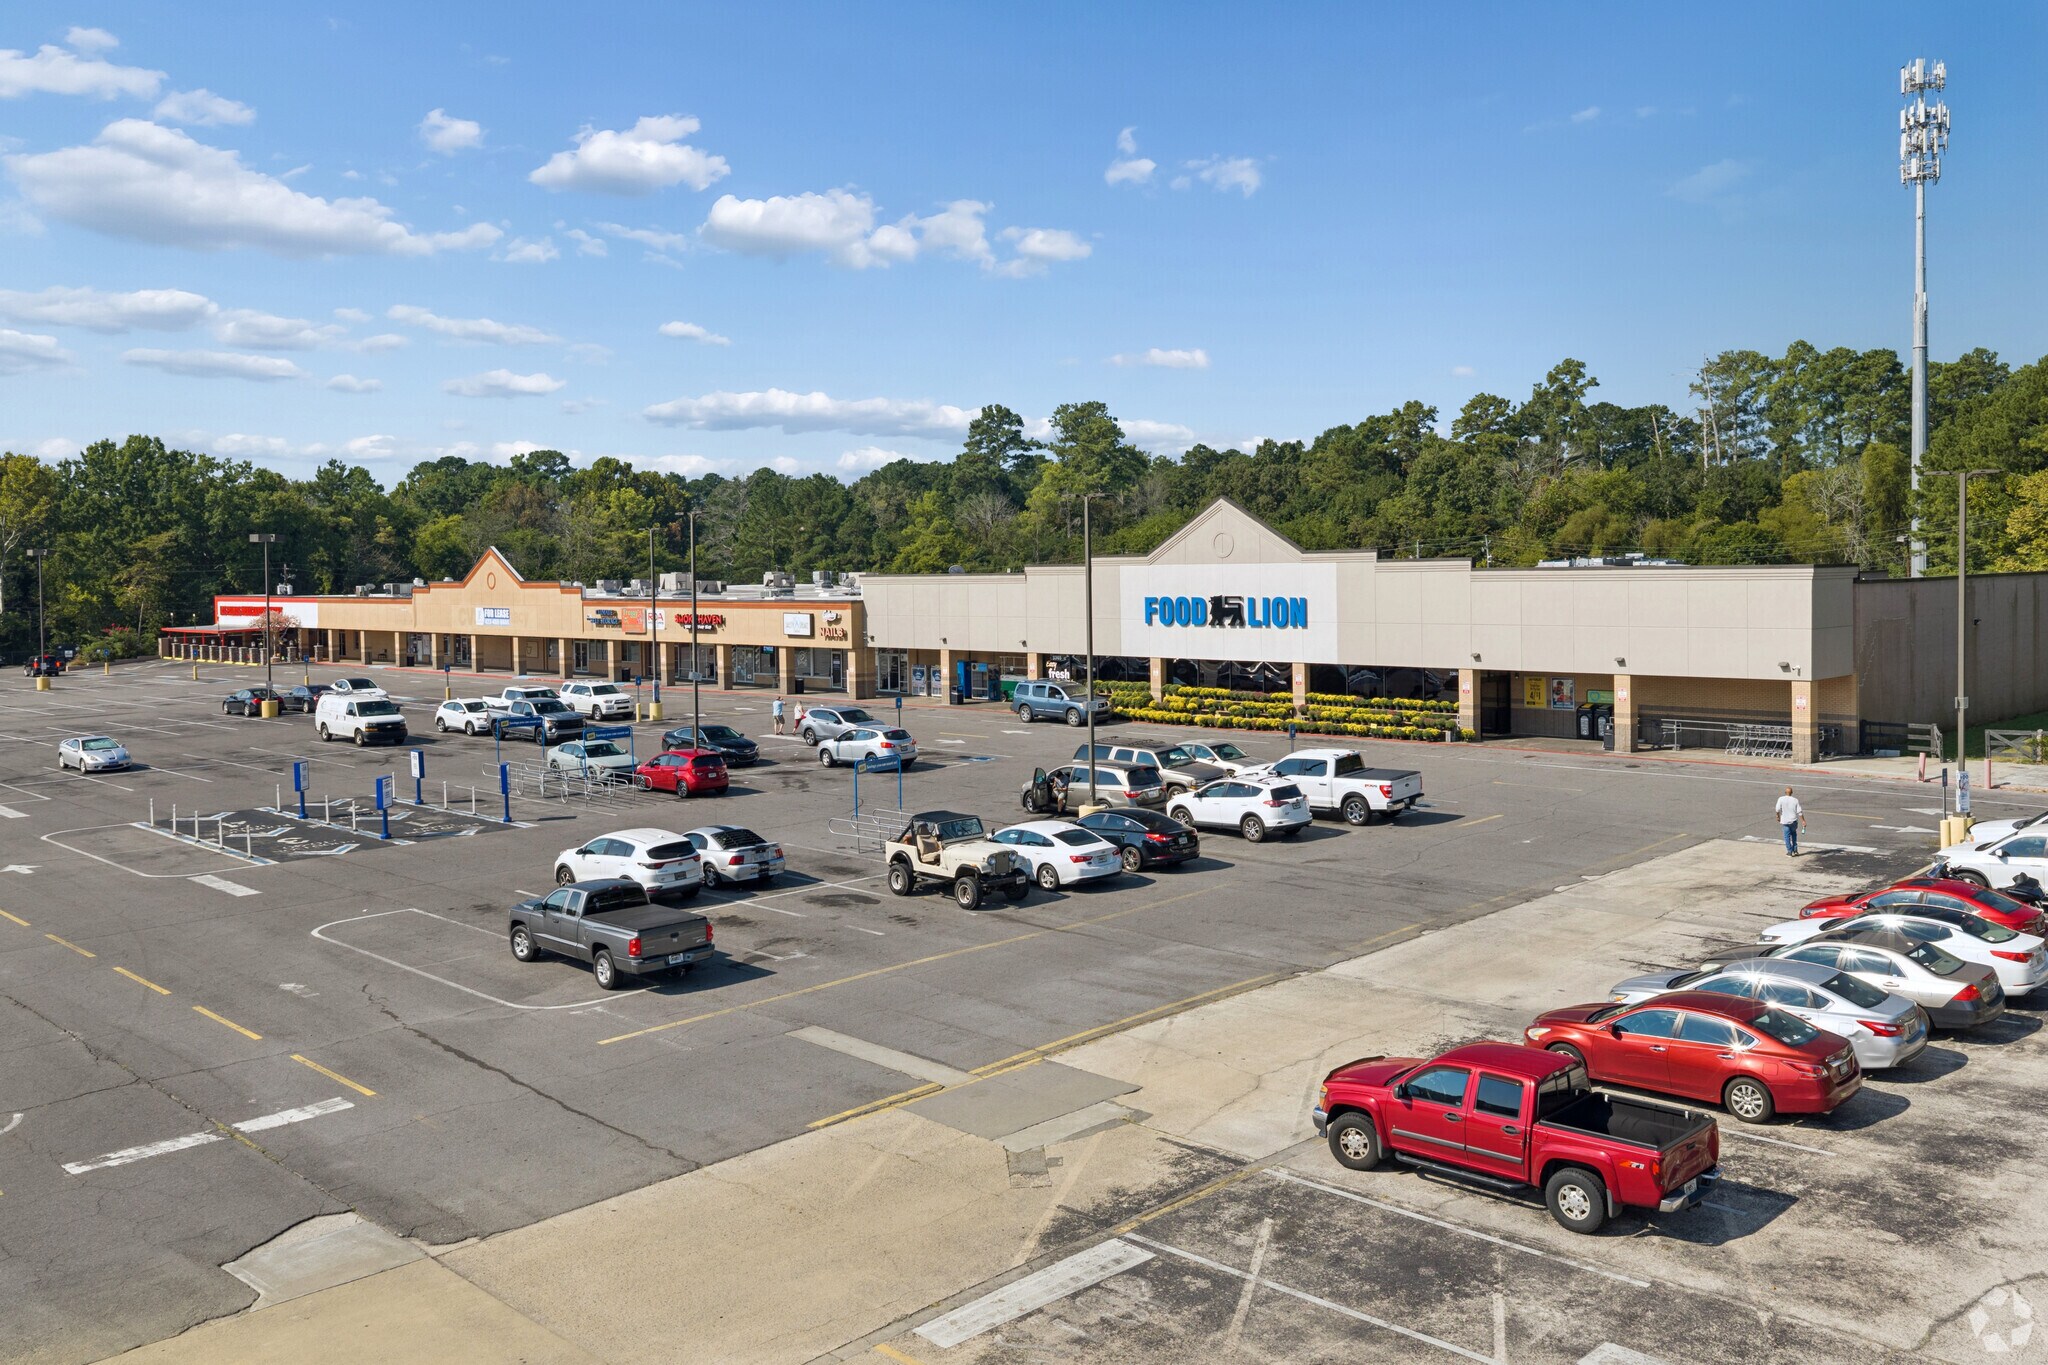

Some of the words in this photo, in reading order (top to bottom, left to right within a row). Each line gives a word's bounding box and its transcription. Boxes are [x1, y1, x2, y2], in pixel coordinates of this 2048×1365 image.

[484, 609, 494, 618] FOR
[494, 609, 510, 618] LEASE
[1144, 596, 1208, 627] FOOD
[1247, 597, 1308, 629] LION
[674, 614, 694, 624] SMOK
[698, 614, 722, 624] HAVEN
[820, 628, 844, 637] NAILS
[1048, 668, 1070, 679] fresh
